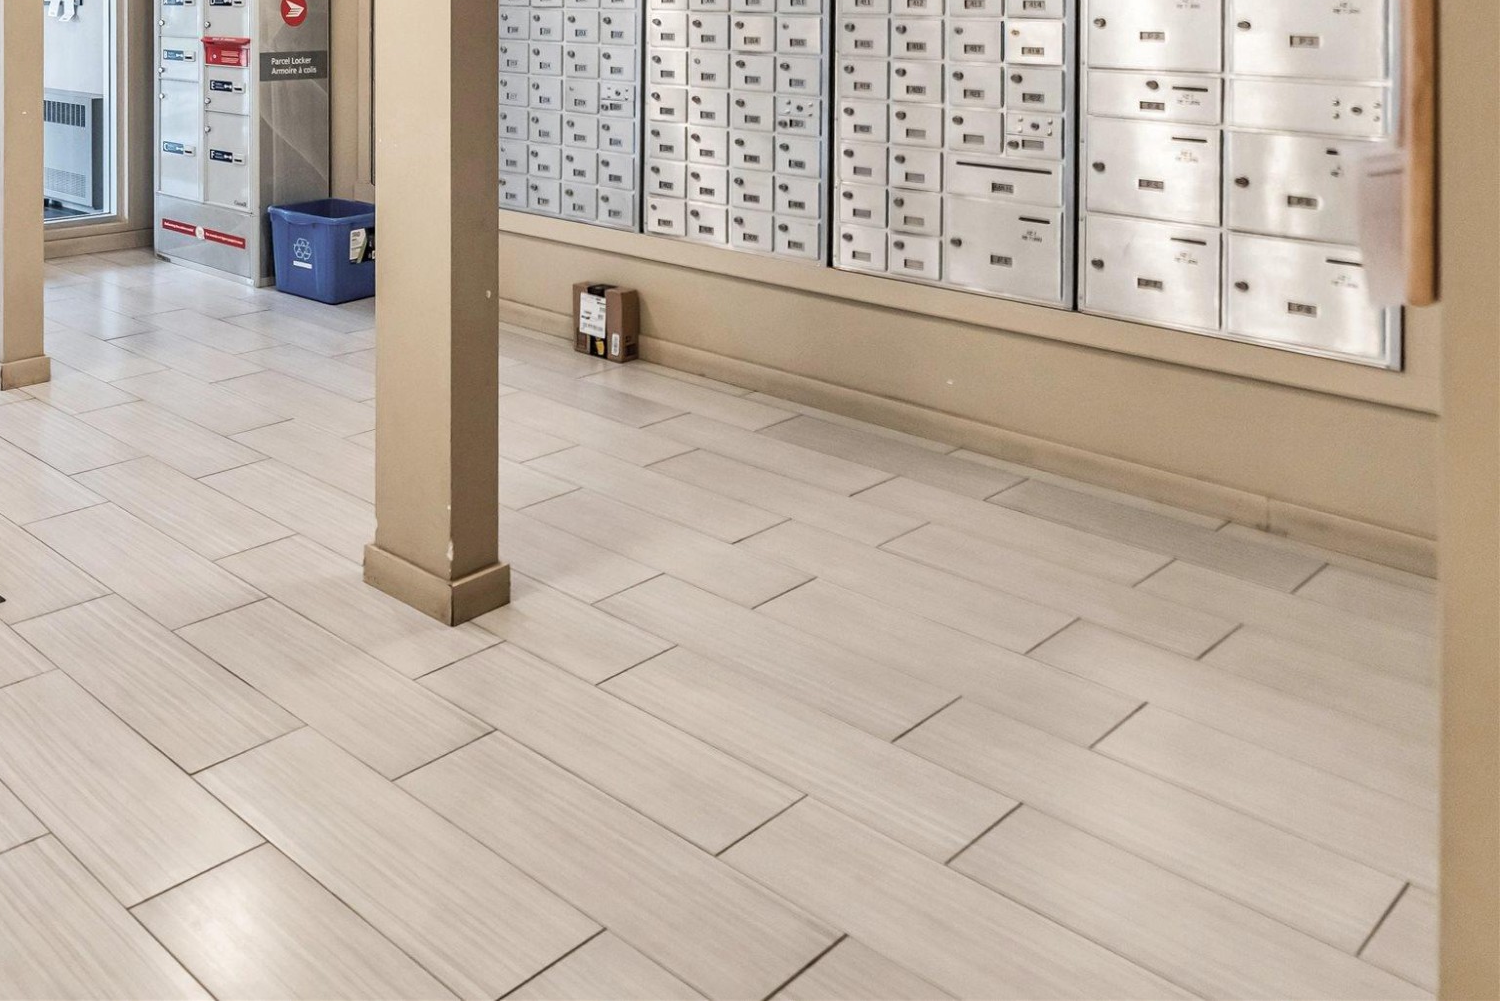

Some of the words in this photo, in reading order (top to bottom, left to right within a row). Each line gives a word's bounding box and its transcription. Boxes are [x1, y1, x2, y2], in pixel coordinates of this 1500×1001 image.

[271, 57, 290, 65] Parcel
[291, 57, 312, 65] Locker
[271, 66, 297, 74] Armoire
[303, 65, 317, 74] colis
